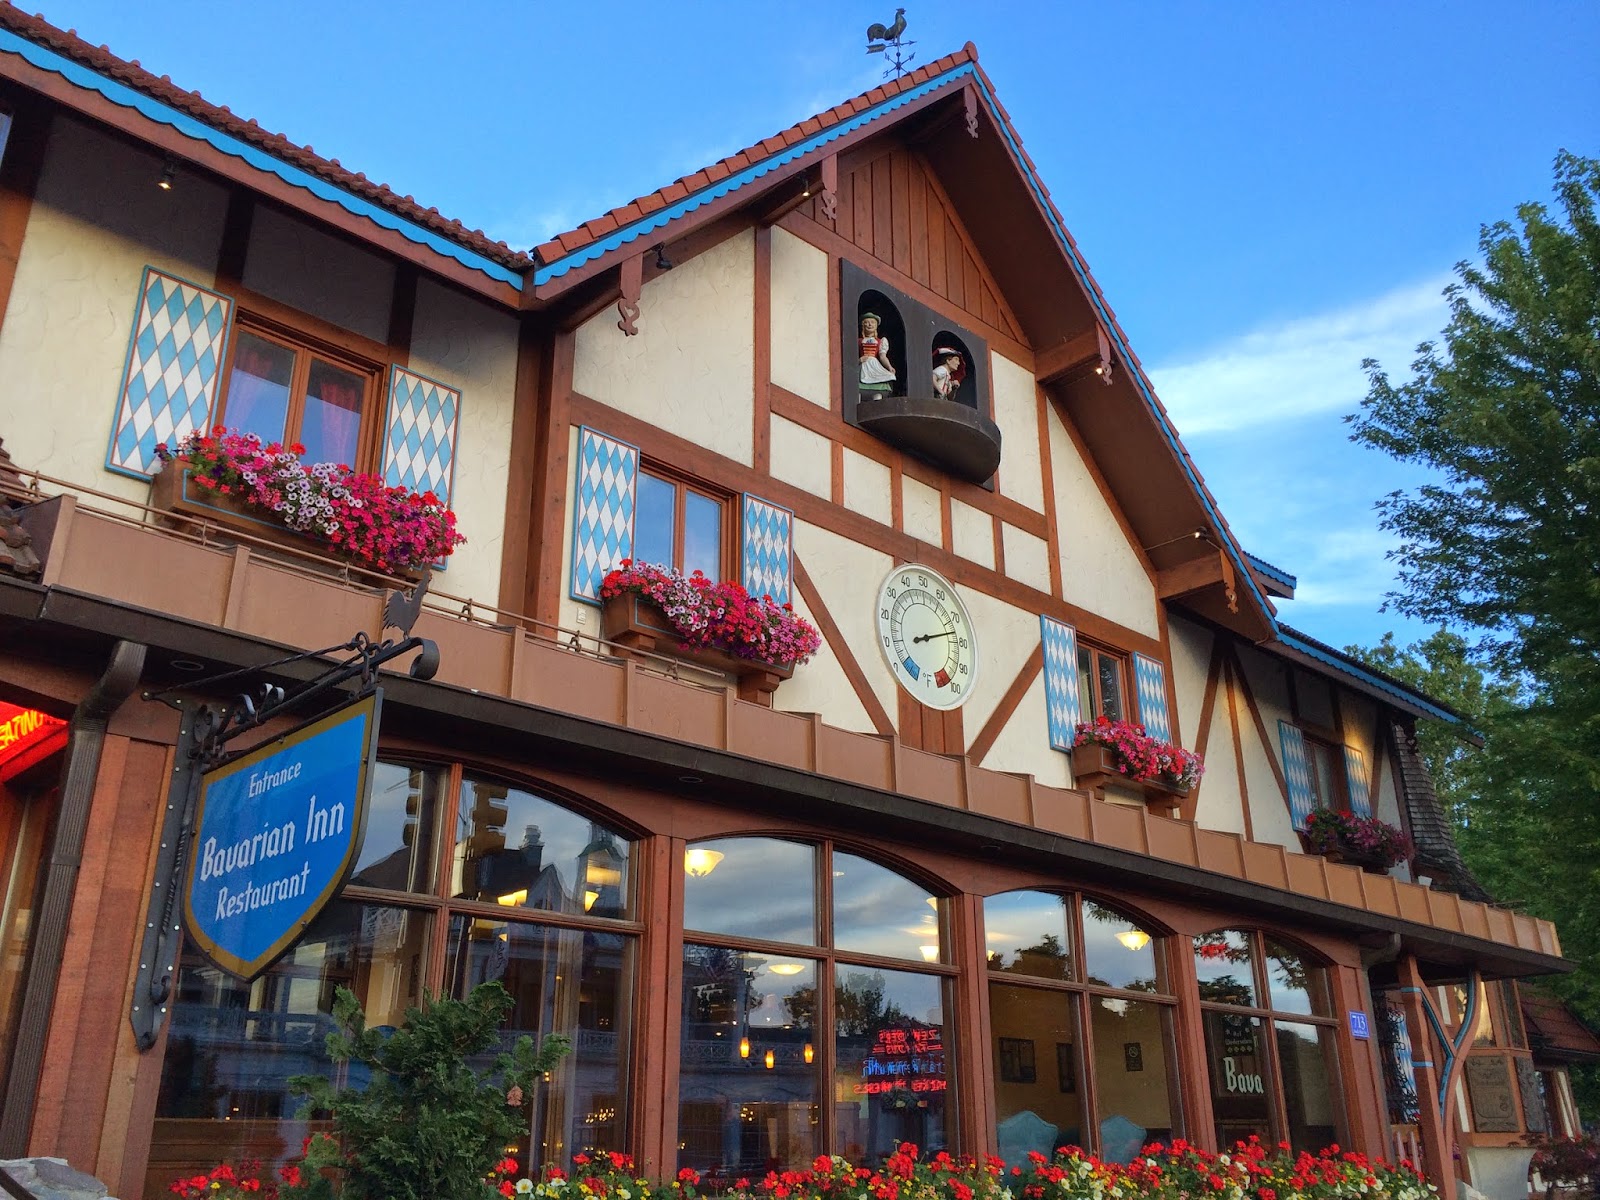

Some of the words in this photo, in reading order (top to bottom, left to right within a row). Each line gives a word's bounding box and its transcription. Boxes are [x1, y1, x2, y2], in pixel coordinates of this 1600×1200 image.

[900, 575, 911, 588] 40
[918, 575, 929, 588] 50
[886, 587, 897, 599] 30
[936, 589, 946, 601] 60
[880, 609, 890, 620] 20
[951, 611, 960, 624] 70
[959, 638, 968, 650] 80
[959, 663, 968, 675] 90
[950, 681, 961, 695] 100
[248, 762, 302, 799] Entrance
[199, 821, 296, 882] Bavarian
[304, 794, 345, 845] Inn
[215, 860, 311, 922] Restaurant
[1351, 1015, 1366, 1030] 713
[1222, 1056, 1265, 1095] Bava
